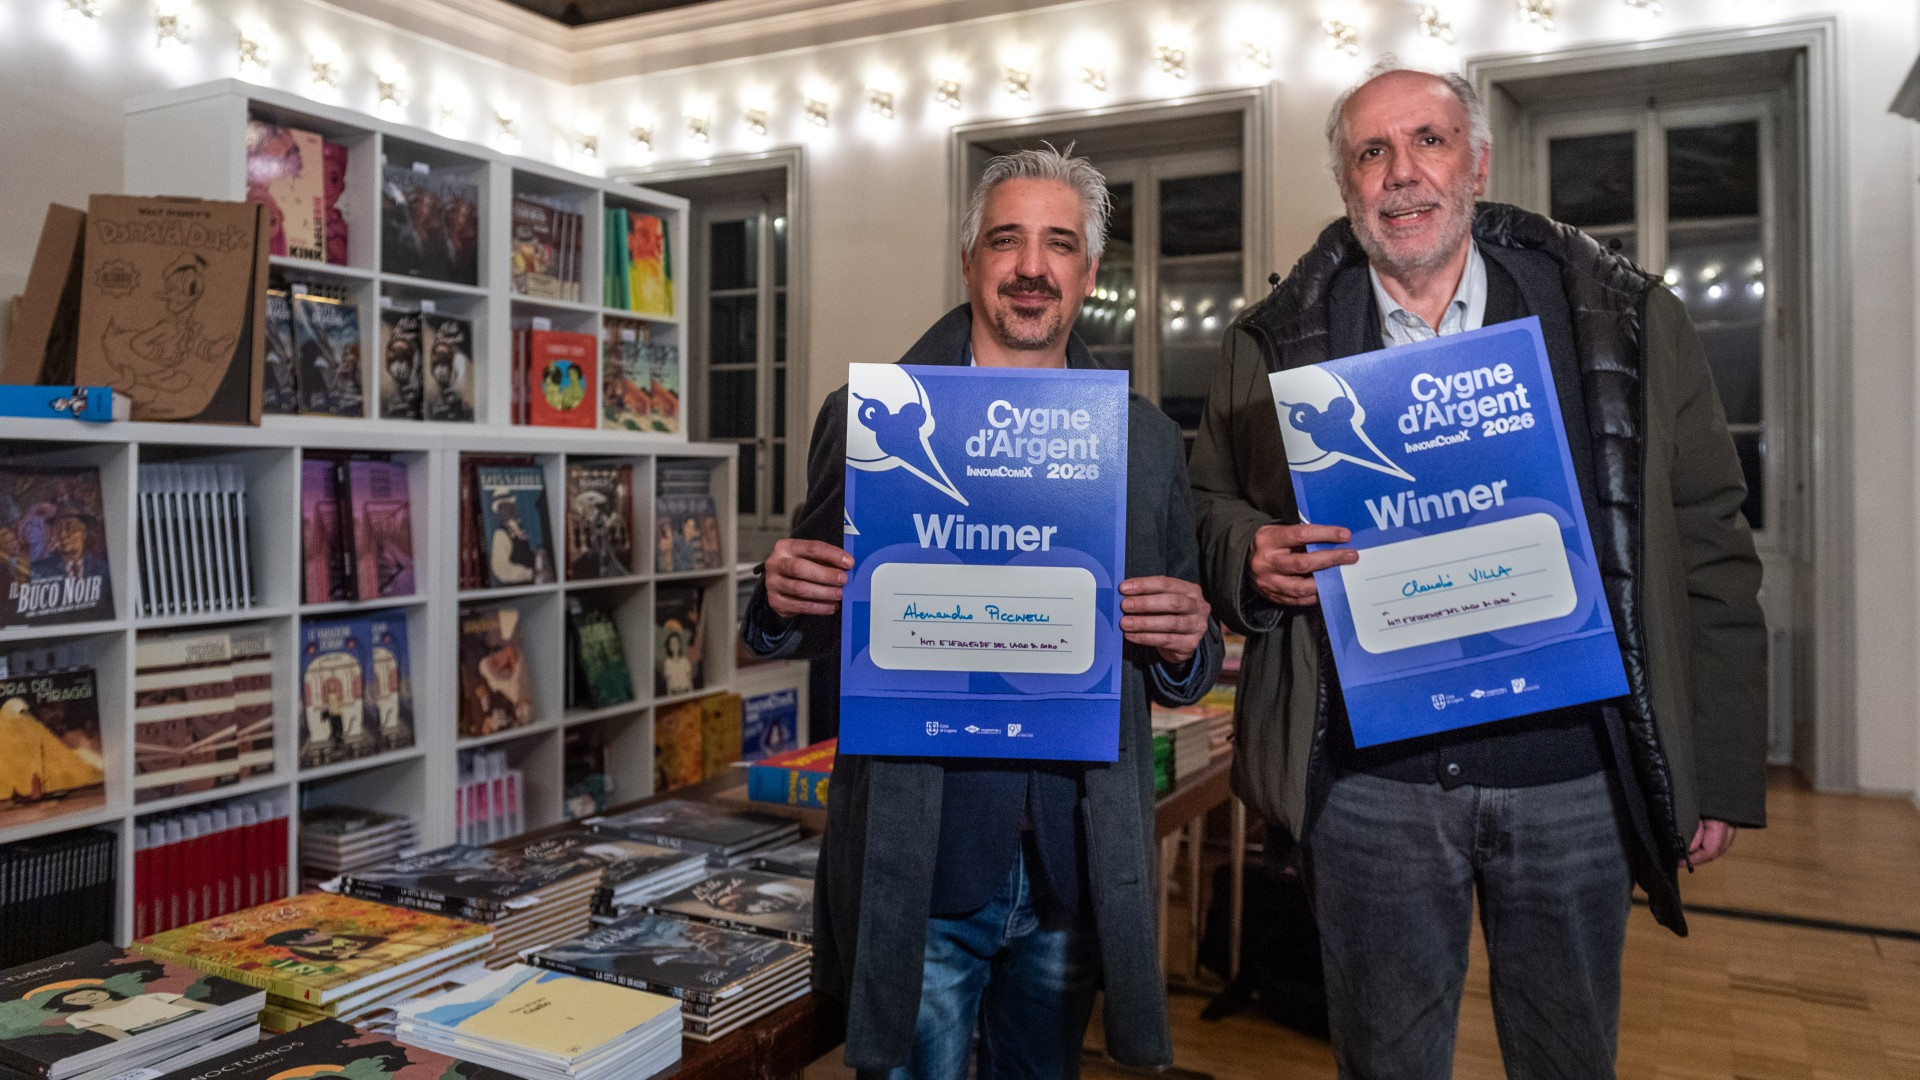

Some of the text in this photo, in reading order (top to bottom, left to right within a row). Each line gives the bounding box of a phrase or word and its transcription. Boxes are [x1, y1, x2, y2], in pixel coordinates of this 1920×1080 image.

[1411, 362, 1514, 403] Cygne
[987, 400, 1091, 435] Cygne
[1397, 383, 1532, 435] d'Argent
[1481, 412, 1536, 438] 2026
[965, 429, 1100, 464] d'Argent
[1046, 463, 1100, 480] 2026
[1364, 479, 1508, 531] Winner
[912, 513, 1058, 551] Winner
[8, 581, 20, 599] IL
[16, 581, 61, 614] BUCO
[61, 575, 103, 606] NOIR
[1402, 565, 1513, 597] Claudio VILLA
[31, 678, 54, 694] DEI
[36, 683, 94, 704] MIRAGGI
[189, 960, 199, 970] LA
[200, 961, 228, 977] FORZA
